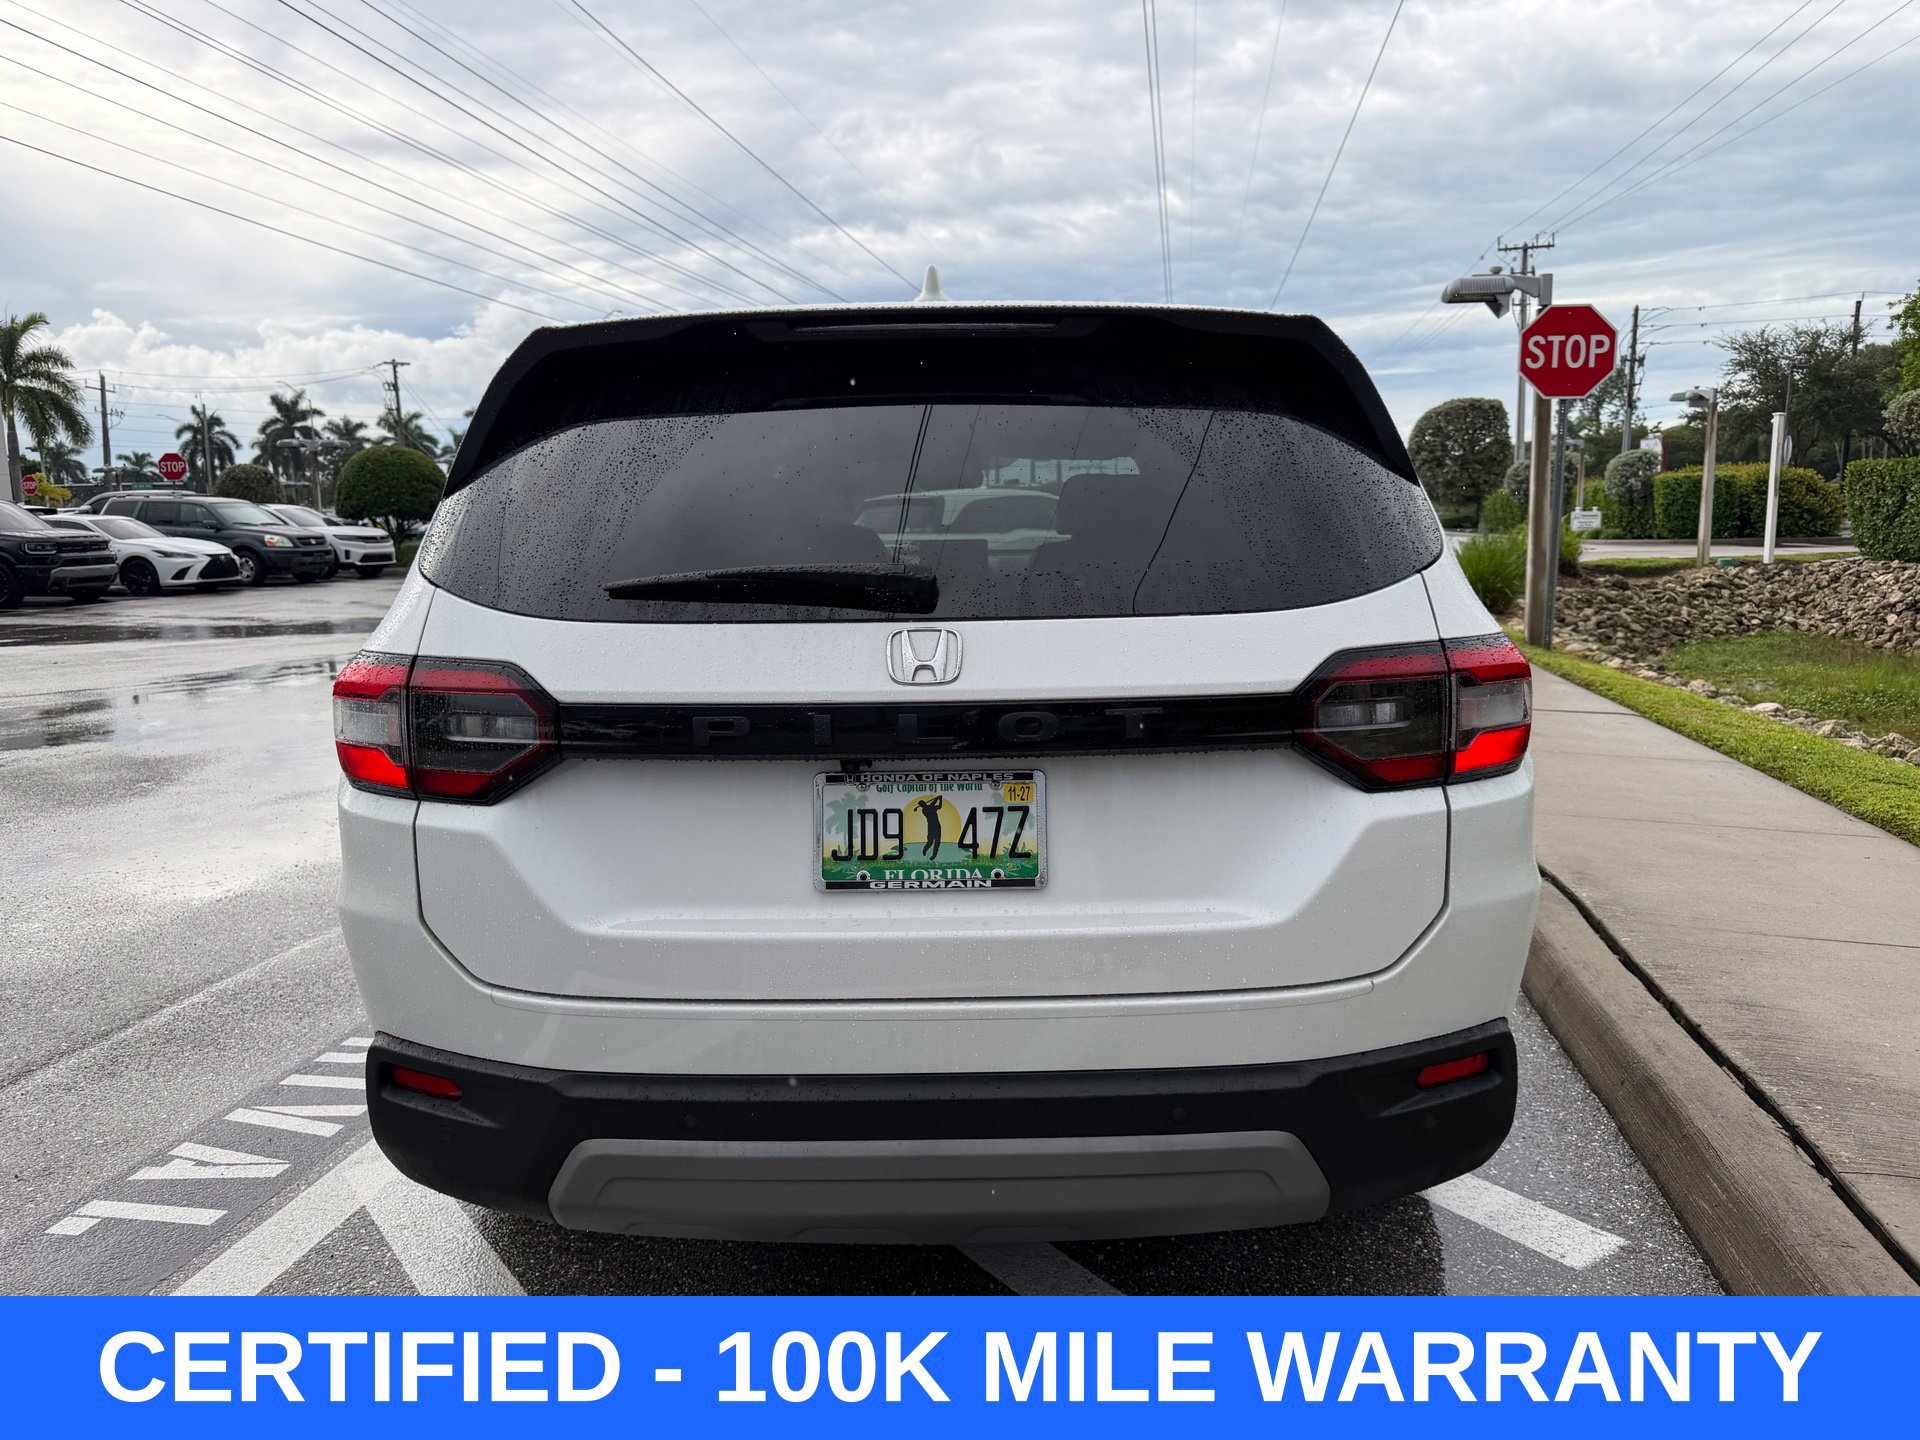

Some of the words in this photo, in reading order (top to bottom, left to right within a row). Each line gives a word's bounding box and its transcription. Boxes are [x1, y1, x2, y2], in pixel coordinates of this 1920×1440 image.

[1525, 334, 1611, 369] STOP
[160, 461, 185, 473] STOP
[22, 481, 37, 490] STOP
[692, 707, 1164, 747] PILOT
[860, 774, 918, 783] HONDA
[922, 773, 943, 782] OF
[947, 772, 1014, 781] NAPLES
[1007, 785, 1031, 802] 11-27
[830, 807, 904, 862] JD9
[957, 805, 1032, 860] 47Z
[883, 867, 983, 880] FLORIDA
[869, 879, 992, 889] GERMAIN
